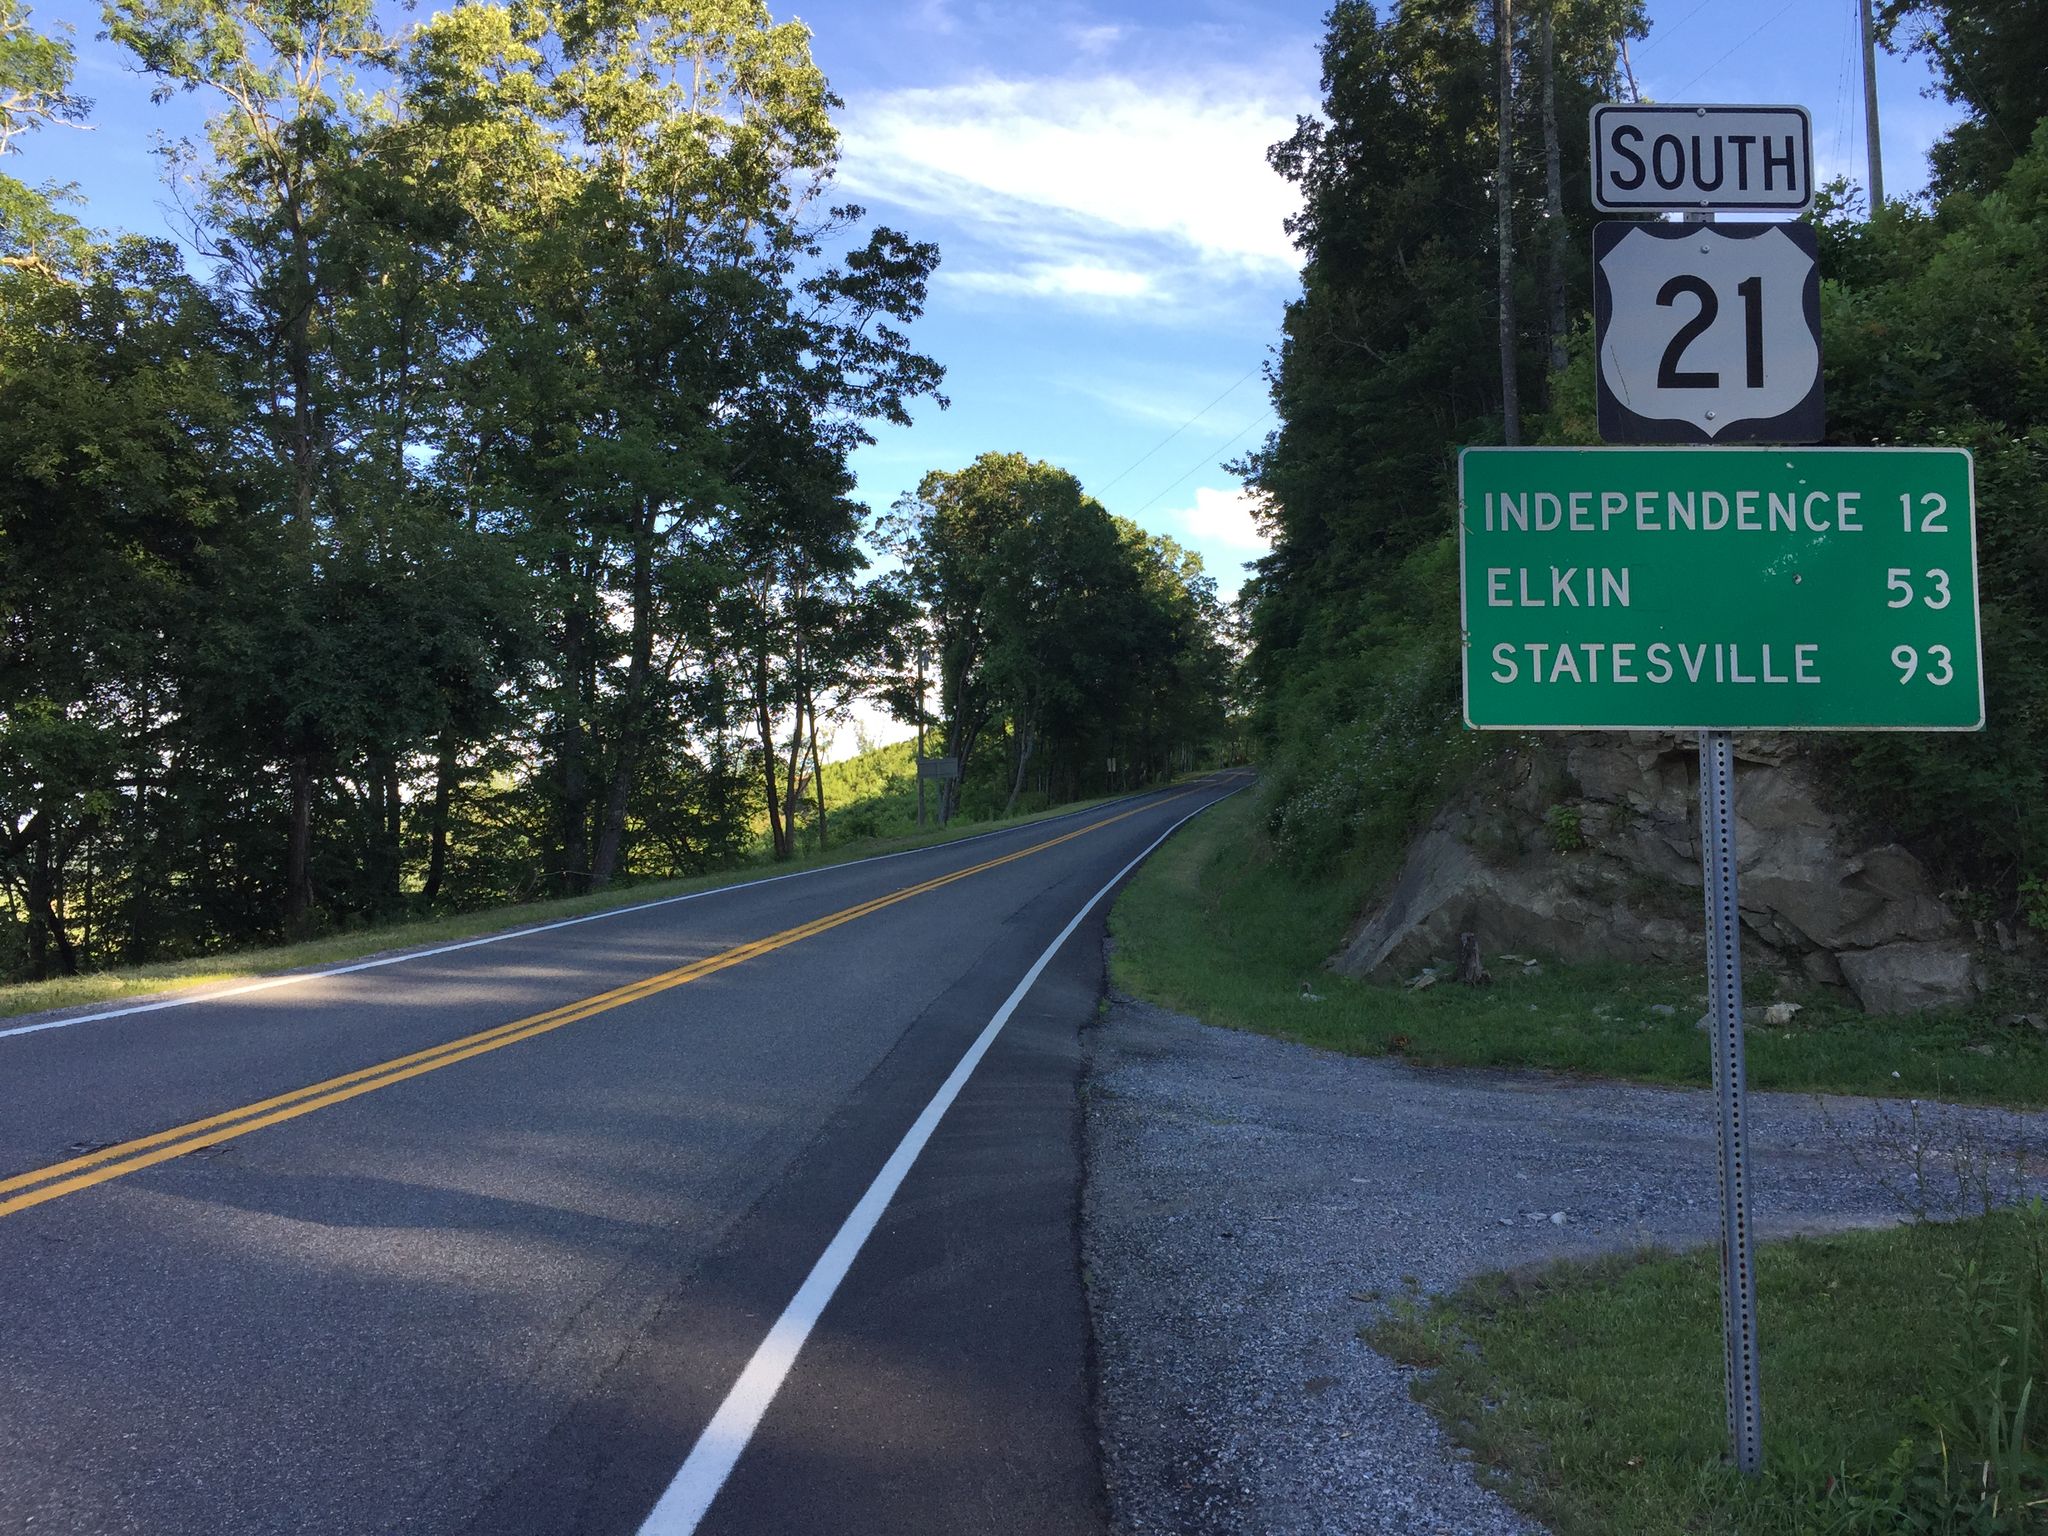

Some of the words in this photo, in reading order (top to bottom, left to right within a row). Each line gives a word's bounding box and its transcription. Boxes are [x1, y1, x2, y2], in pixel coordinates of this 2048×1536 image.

[1609, 124, 1797, 193] SOUTH
[1655, 274, 1765, 389] 21
[1485, 491, 1863, 532] INDEPENDENCE
[1899, 492, 1948, 533] 12
[1487, 567, 1630, 607] ELKIN
[1887, 568, 1951, 610] 53
[1491, 642, 1821, 684] STATESVILLE
[1891, 644, 1954, 686] 93
